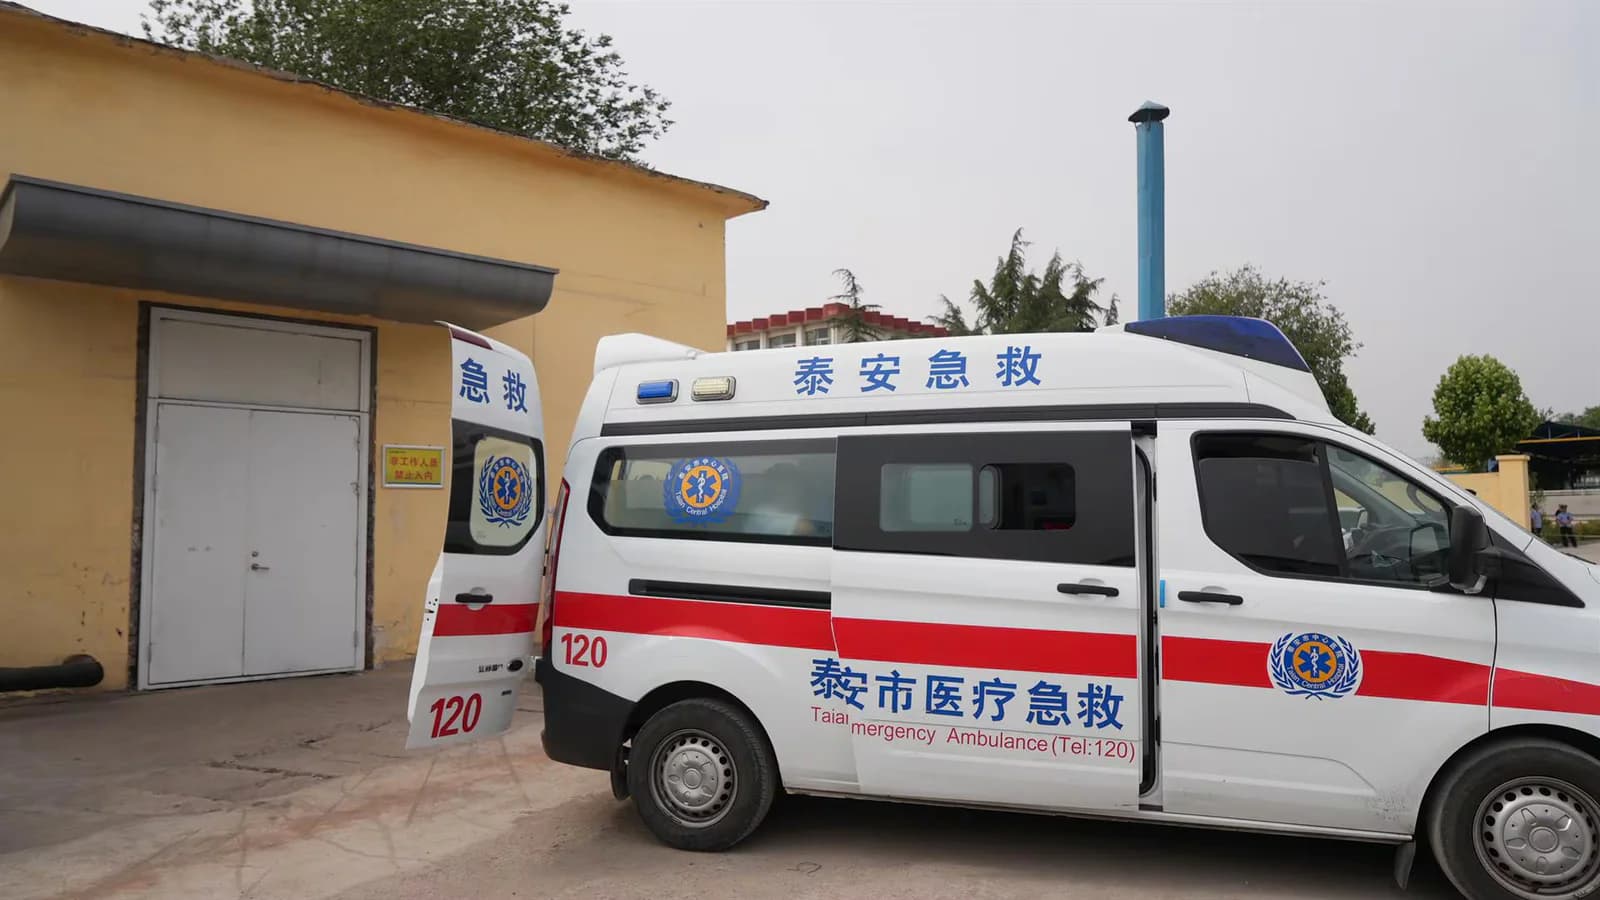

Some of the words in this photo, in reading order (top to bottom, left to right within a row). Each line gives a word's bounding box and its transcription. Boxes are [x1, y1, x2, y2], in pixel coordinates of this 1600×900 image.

[459, 357, 528, 414] 急救
[793, 345, 1043, 396] 泰安急救
[391, 456, 439, 468] 非工作人员
[395, 470, 433, 481] 禁止入内
[561, 633, 608, 668] 120
[810, 657, 1125, 730] 泰安市医疗急救
[430, 693, 483, 739] 120
[851, 722, 937, 745] mergency
